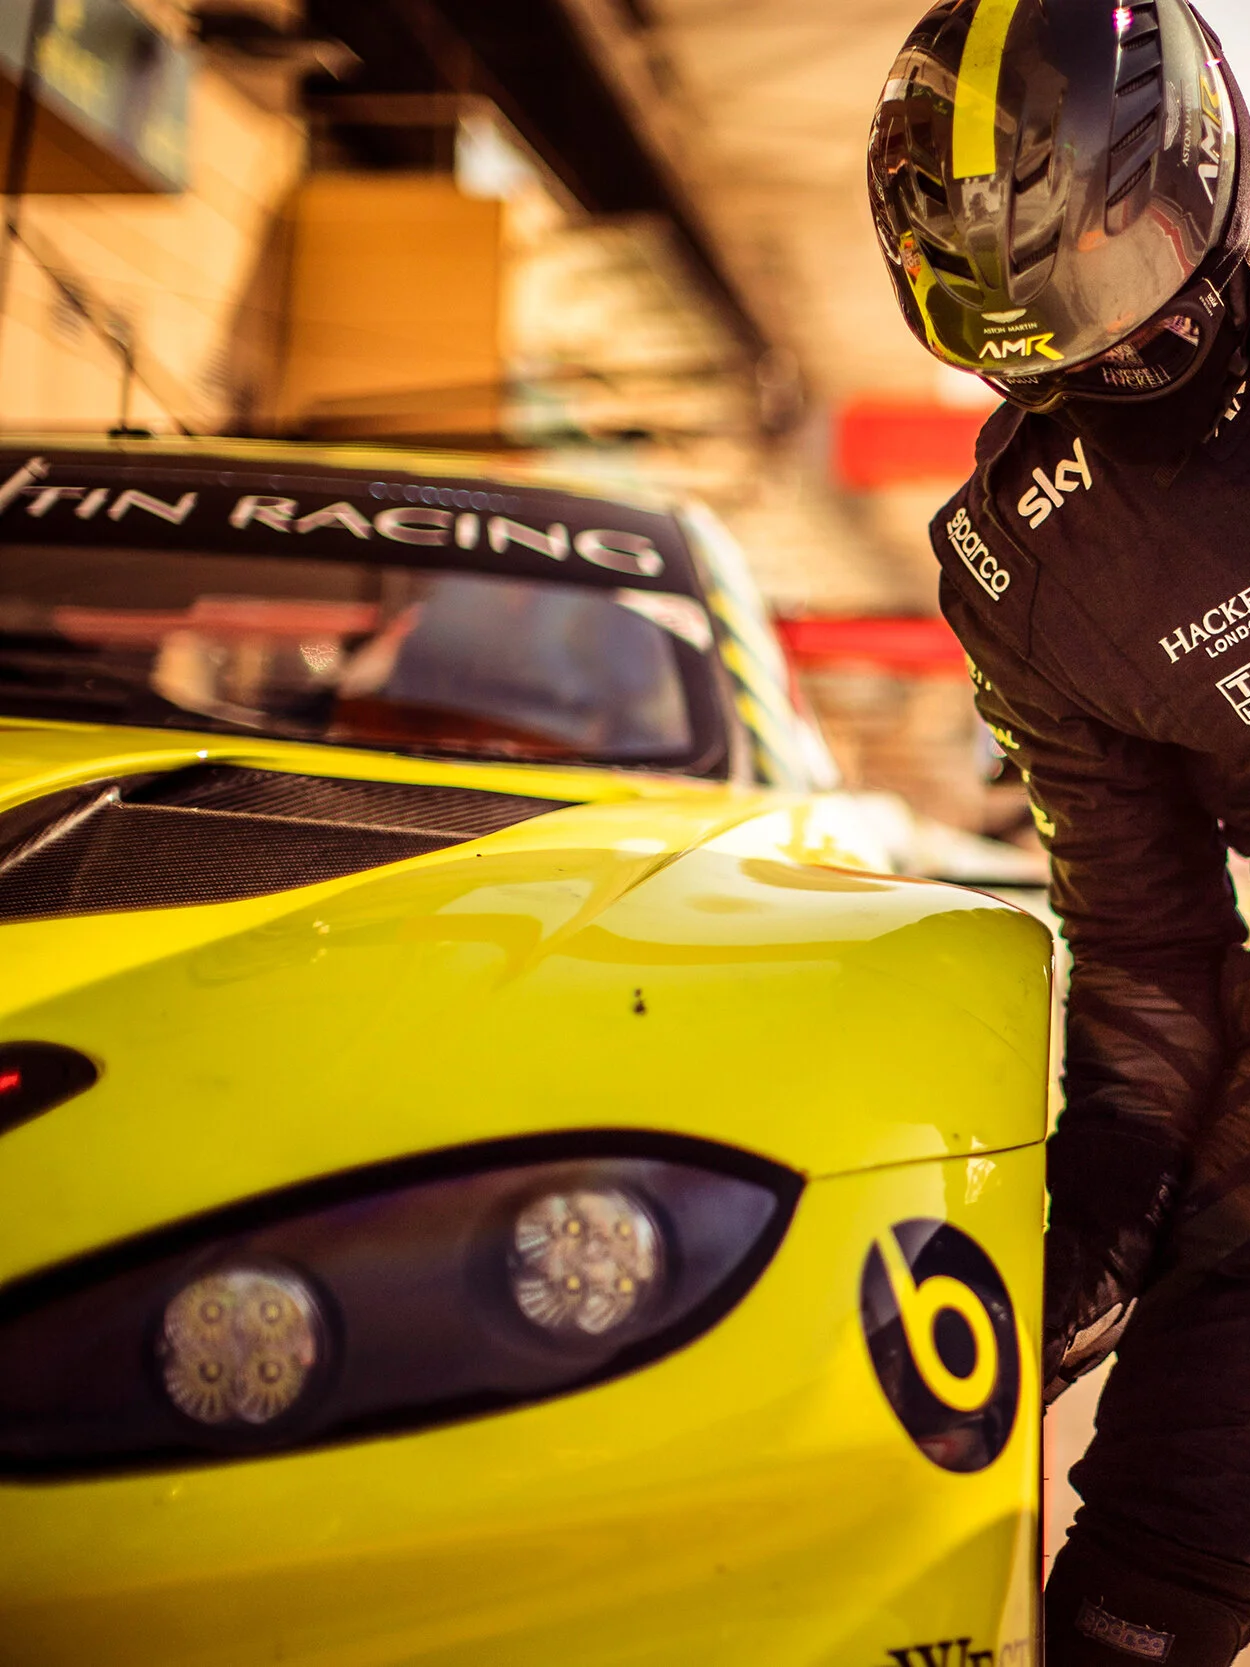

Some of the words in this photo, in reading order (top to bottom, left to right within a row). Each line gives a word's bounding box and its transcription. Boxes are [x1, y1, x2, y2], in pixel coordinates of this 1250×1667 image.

[1182, 129, 1191, 167] ASTON
[979, 332, 1065, 361] AMR
[983, 327, 1006, 335] ASTON
[1008, 322, 1038, 332] MARTIN
[1017, 437, 1093, 530] sky
[229, 495, 665, 578] RACING
[947, 507, 1010, 601] sparco
